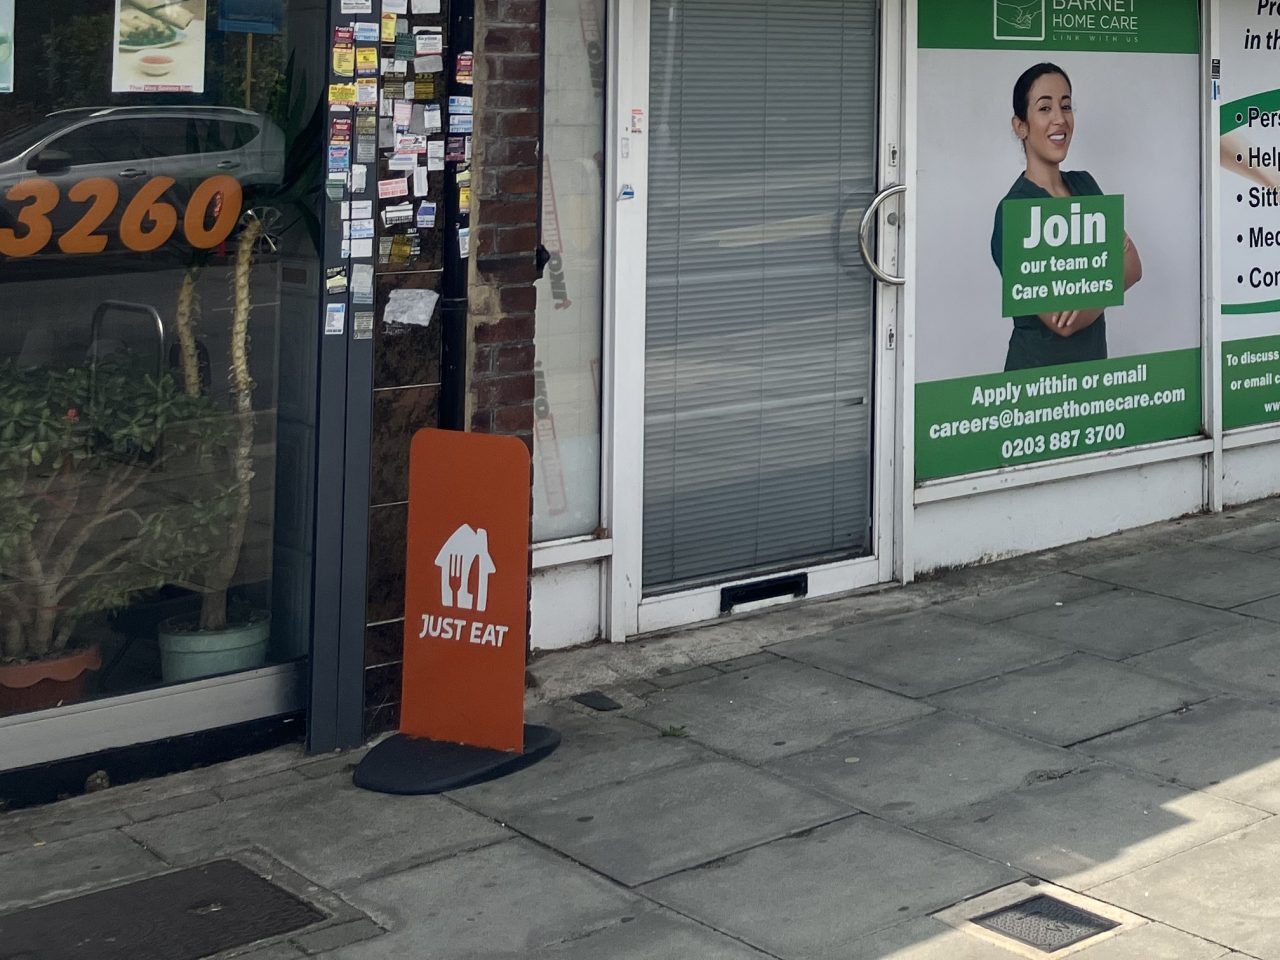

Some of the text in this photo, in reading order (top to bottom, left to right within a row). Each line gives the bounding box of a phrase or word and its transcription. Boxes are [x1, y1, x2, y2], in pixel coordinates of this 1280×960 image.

[1052, 13, 1138, 30] HOME CARE
[1244, 28, 1261, 50] in
[0, 175, 243, 257] 3260
[1023, 203, 1106, 248] Join
[1021, 251, 1108, 274] our team of
[1012, 277, 1113, 300] Care Workers
[1226, 353, 1238, 367] To
[1240, 348, 1279, 365] discuss
[971, 364, 1147, 407] Apply within or email
[1230, 378, 1242, 390] or
[1244, 372, 1273, 388] email
[929, 387, 1186, 439] careers@barnethomecare.com
[1002, 422, 1125, 459] 0203 887 3700
[420, 614, 508, 647] JUST EAT
